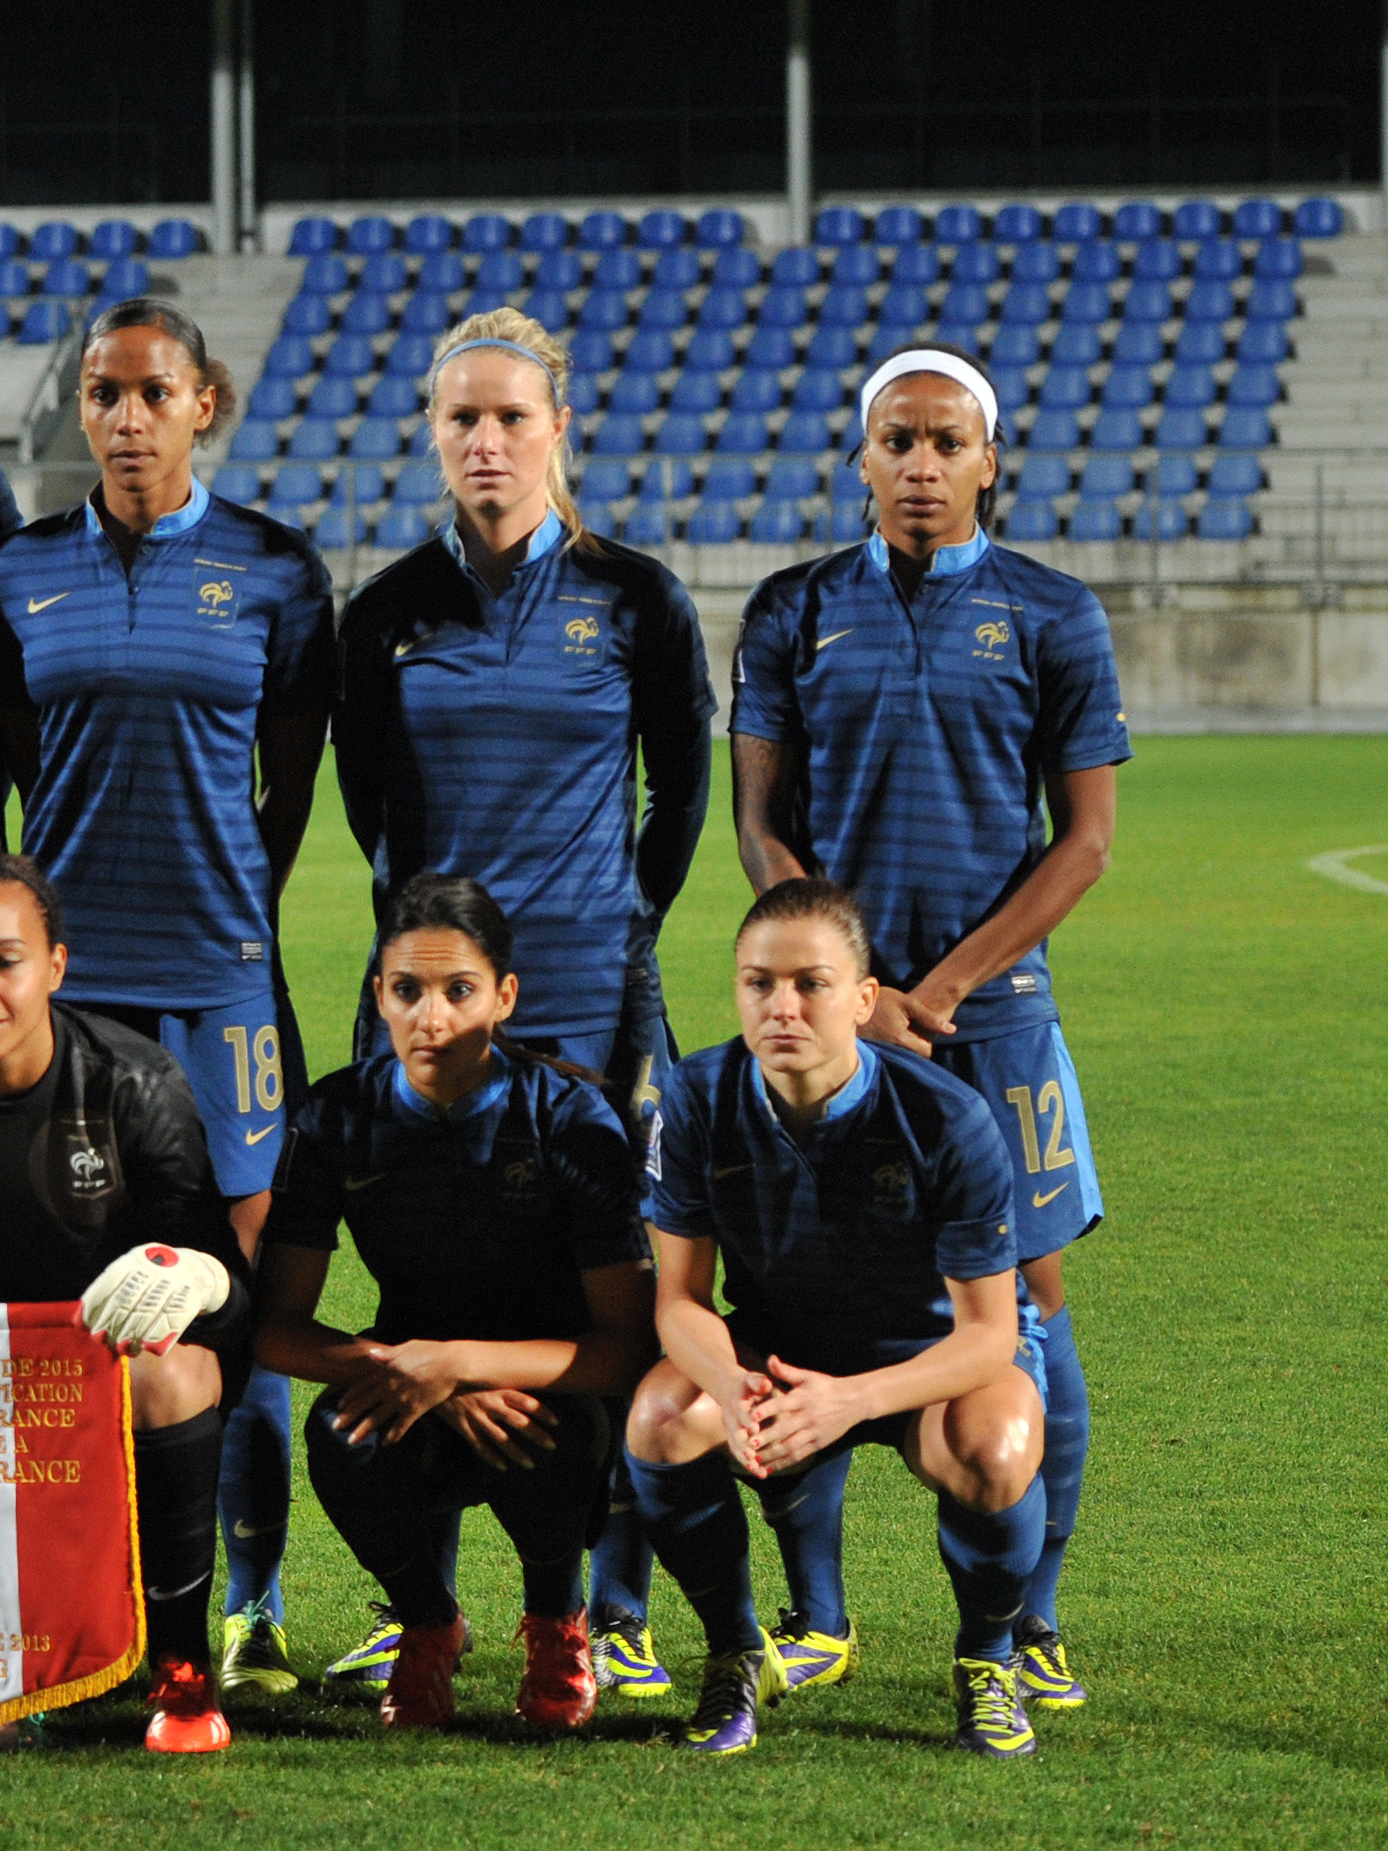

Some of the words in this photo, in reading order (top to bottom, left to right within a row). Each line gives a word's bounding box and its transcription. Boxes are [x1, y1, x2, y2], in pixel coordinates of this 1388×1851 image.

[223, 1025, 285, 1113] 18
[1006, 1080, 1075, 1174] 12
[40, 1358, 83, 1377] 2015
[14, 1435, 30, 1454] A
[10, 1634, 51, 1652] 2013
